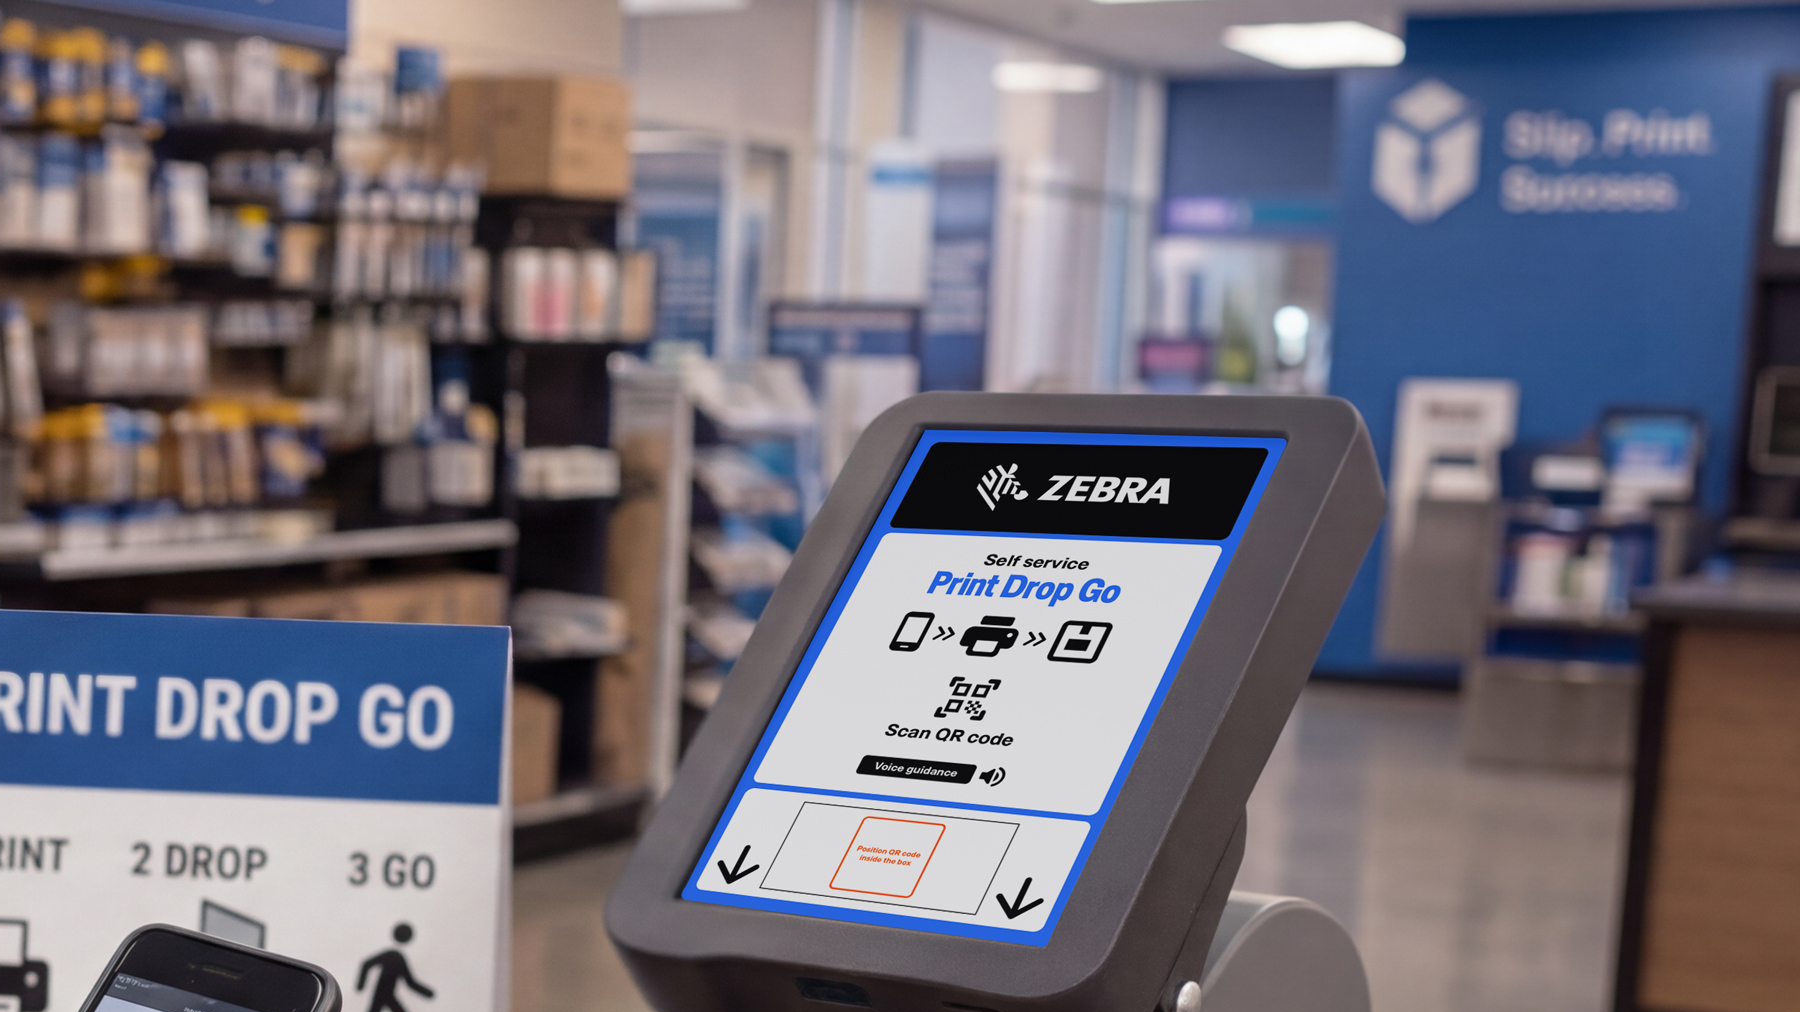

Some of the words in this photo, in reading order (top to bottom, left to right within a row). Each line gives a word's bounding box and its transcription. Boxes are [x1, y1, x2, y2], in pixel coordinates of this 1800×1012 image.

[1037, 474, 1171, 505] ZEBRA
[983, 553, 1022, 567] Self
[1023, 557, 1090, 570] service
[926, 570, 1000, 597] Print
[999, 573, 1074, 607] Drop
[1078, 577, 1121, 603] Go
[153, 675, 339, 746] DROP
[357, 683, 455, 751] GO
[884, 723, 931, 739] Scan
[935, 727, 965, 742] QR
[967, 733, 1014, 746] code
[874, 761, 904, 772] Voice
[905, 763, 958, 777] guidance
[131, 842, 153, 877] 2
[165, 843, 269, 882] DROP
[856, 845, 887, 855] Position
[888, 848, 901, 856] QR
[901, 850, 921, 858] code
[858, 854, 881, 862] inside
[896, 858, 912, 866] box
[347, 852, 369, 887] 3
[382, 853, 437, 890] GO
